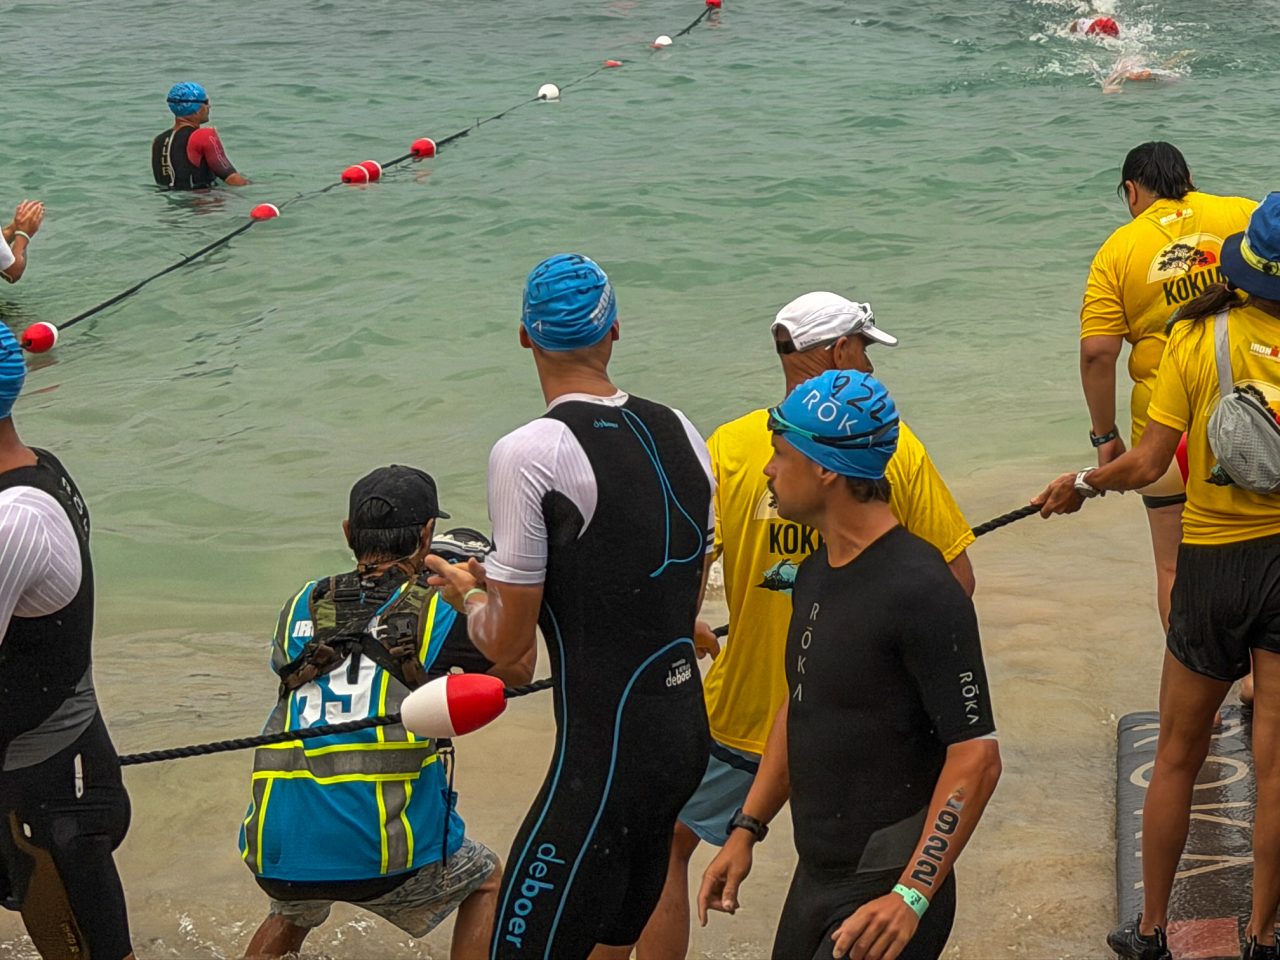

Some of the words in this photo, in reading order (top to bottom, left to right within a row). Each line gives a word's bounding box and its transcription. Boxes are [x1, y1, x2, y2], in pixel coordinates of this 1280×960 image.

[802, 389, 859, 435] RŌK
[769, 523, 824, 556] KOK
[505, 843, 566, 949] deboer
